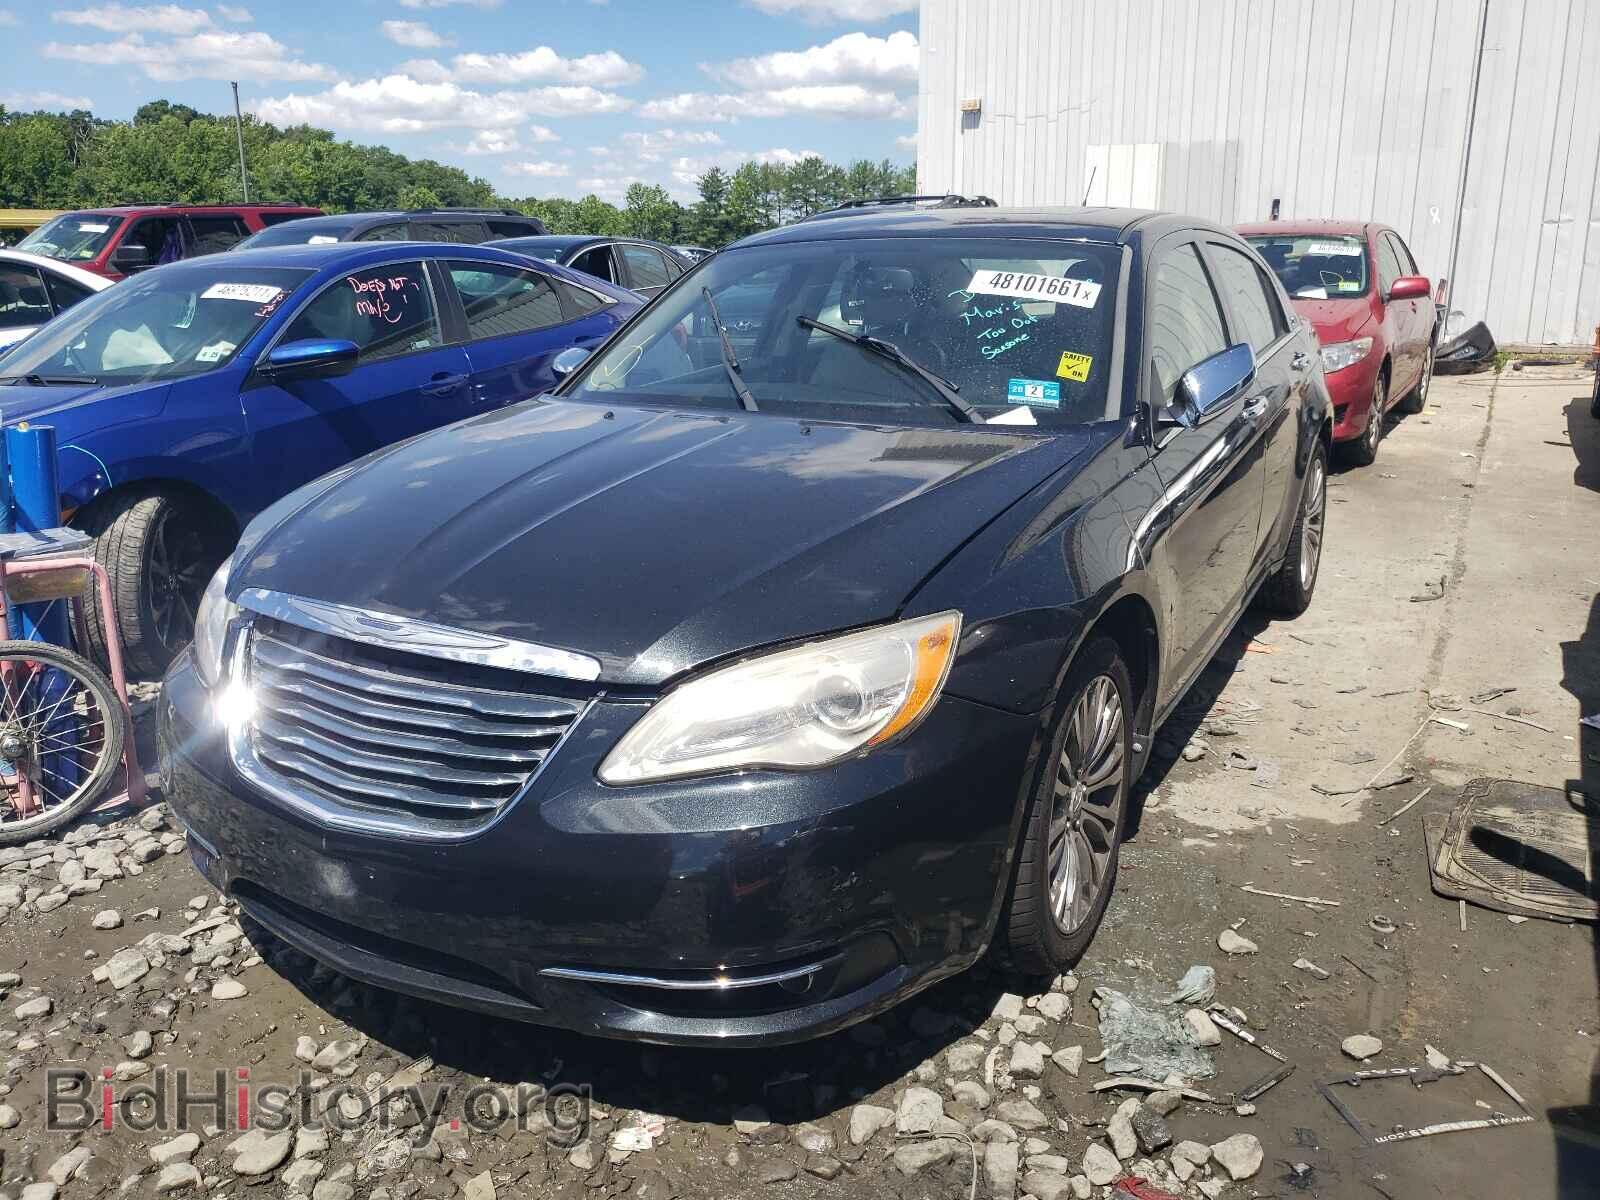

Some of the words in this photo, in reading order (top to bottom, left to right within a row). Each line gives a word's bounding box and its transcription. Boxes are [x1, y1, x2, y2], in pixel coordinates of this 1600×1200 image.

[990, 273, 1081, 298] 48101661
[1063, 352, 1090, 364] SAFETY
[1031, 386, 1038, 396] 2
